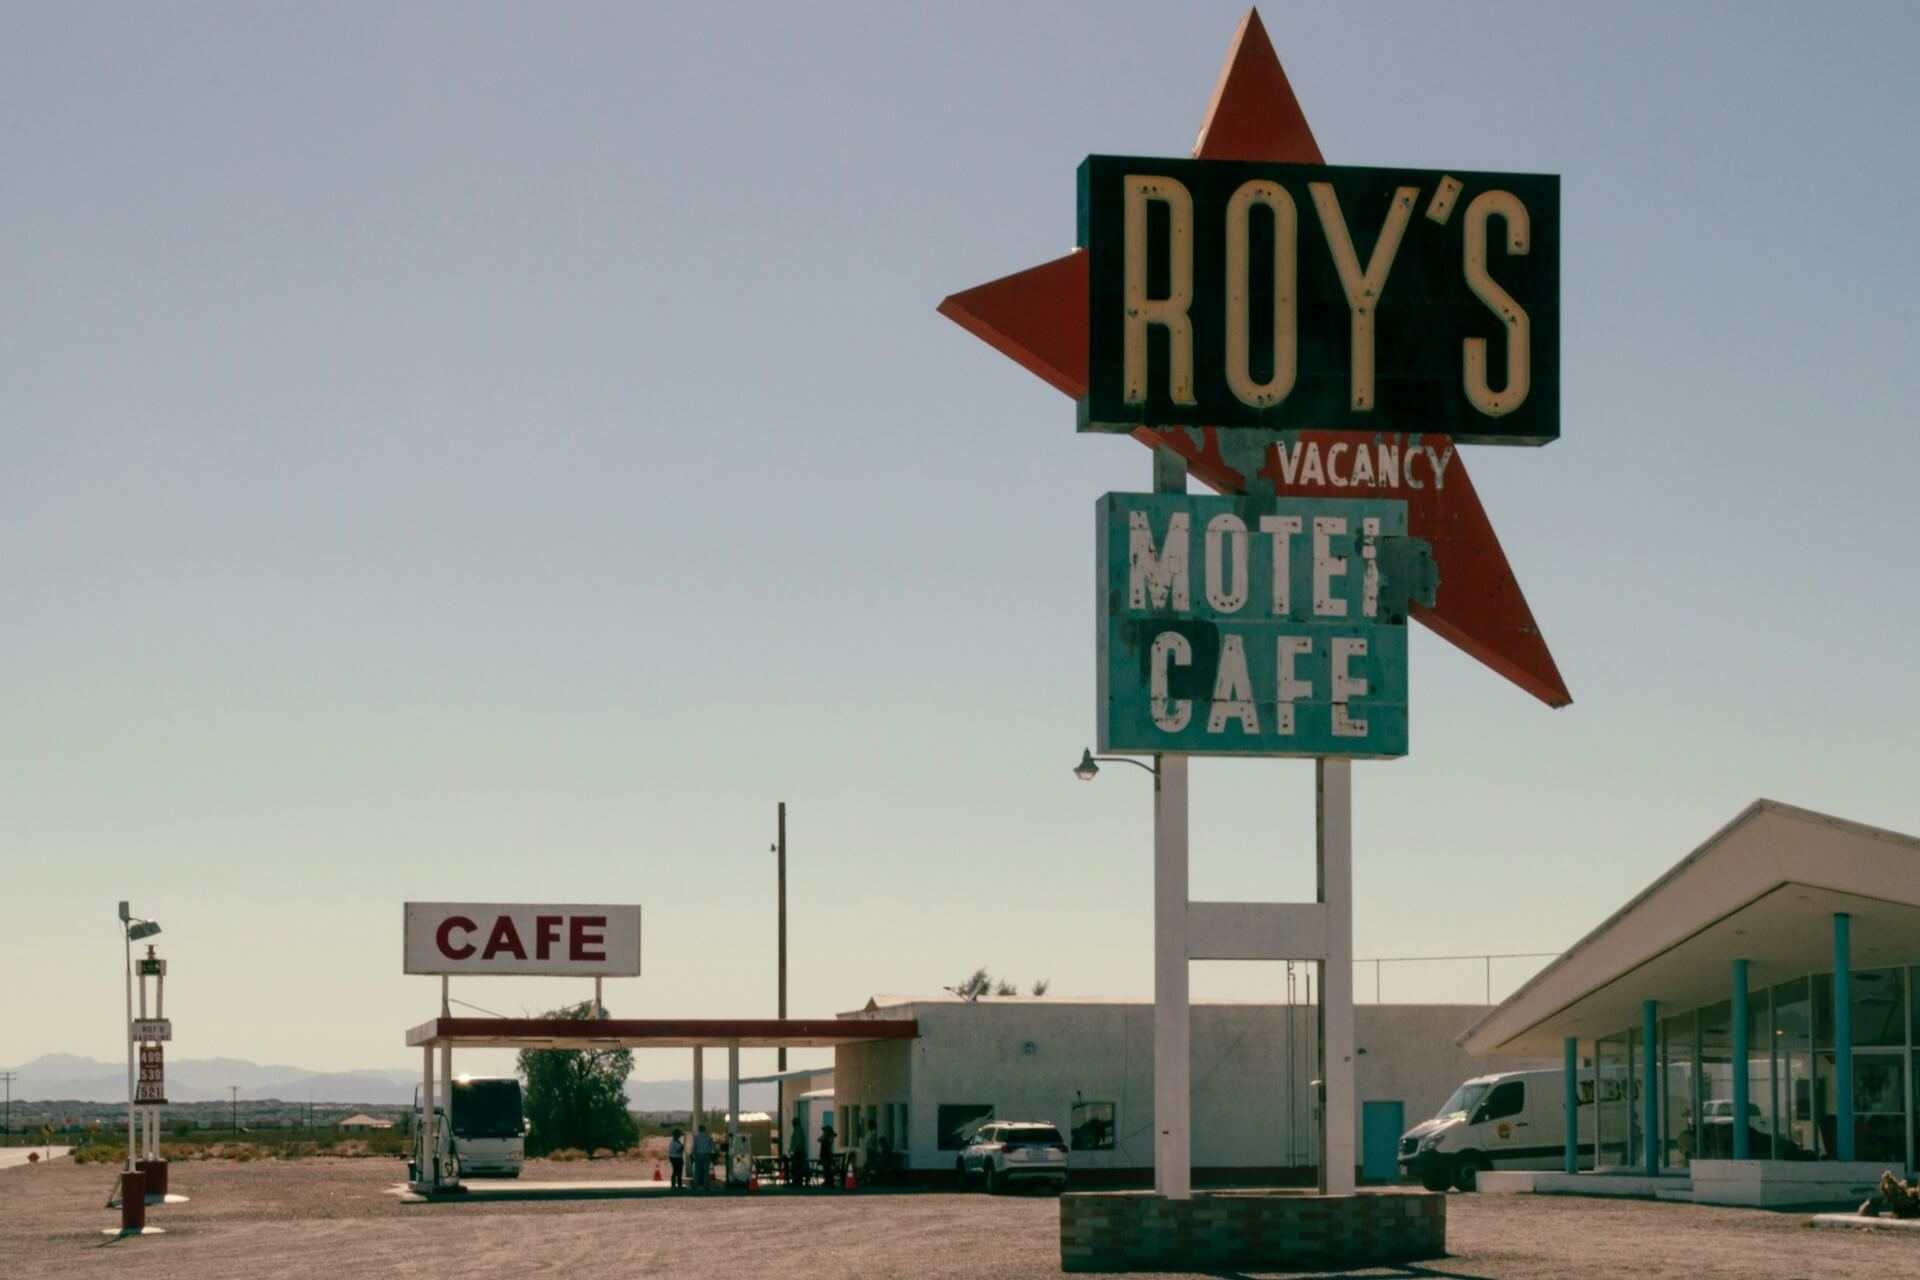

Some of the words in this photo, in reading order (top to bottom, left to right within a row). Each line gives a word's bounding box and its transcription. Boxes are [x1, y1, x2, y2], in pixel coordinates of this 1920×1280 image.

[1124, 175, 1531, 417] ROY'S
[1275, 440, 1454, 490] VACANCY
[1150, 631, 1369, 737] CAFE
[436, 915, 607, 961] CAFE
